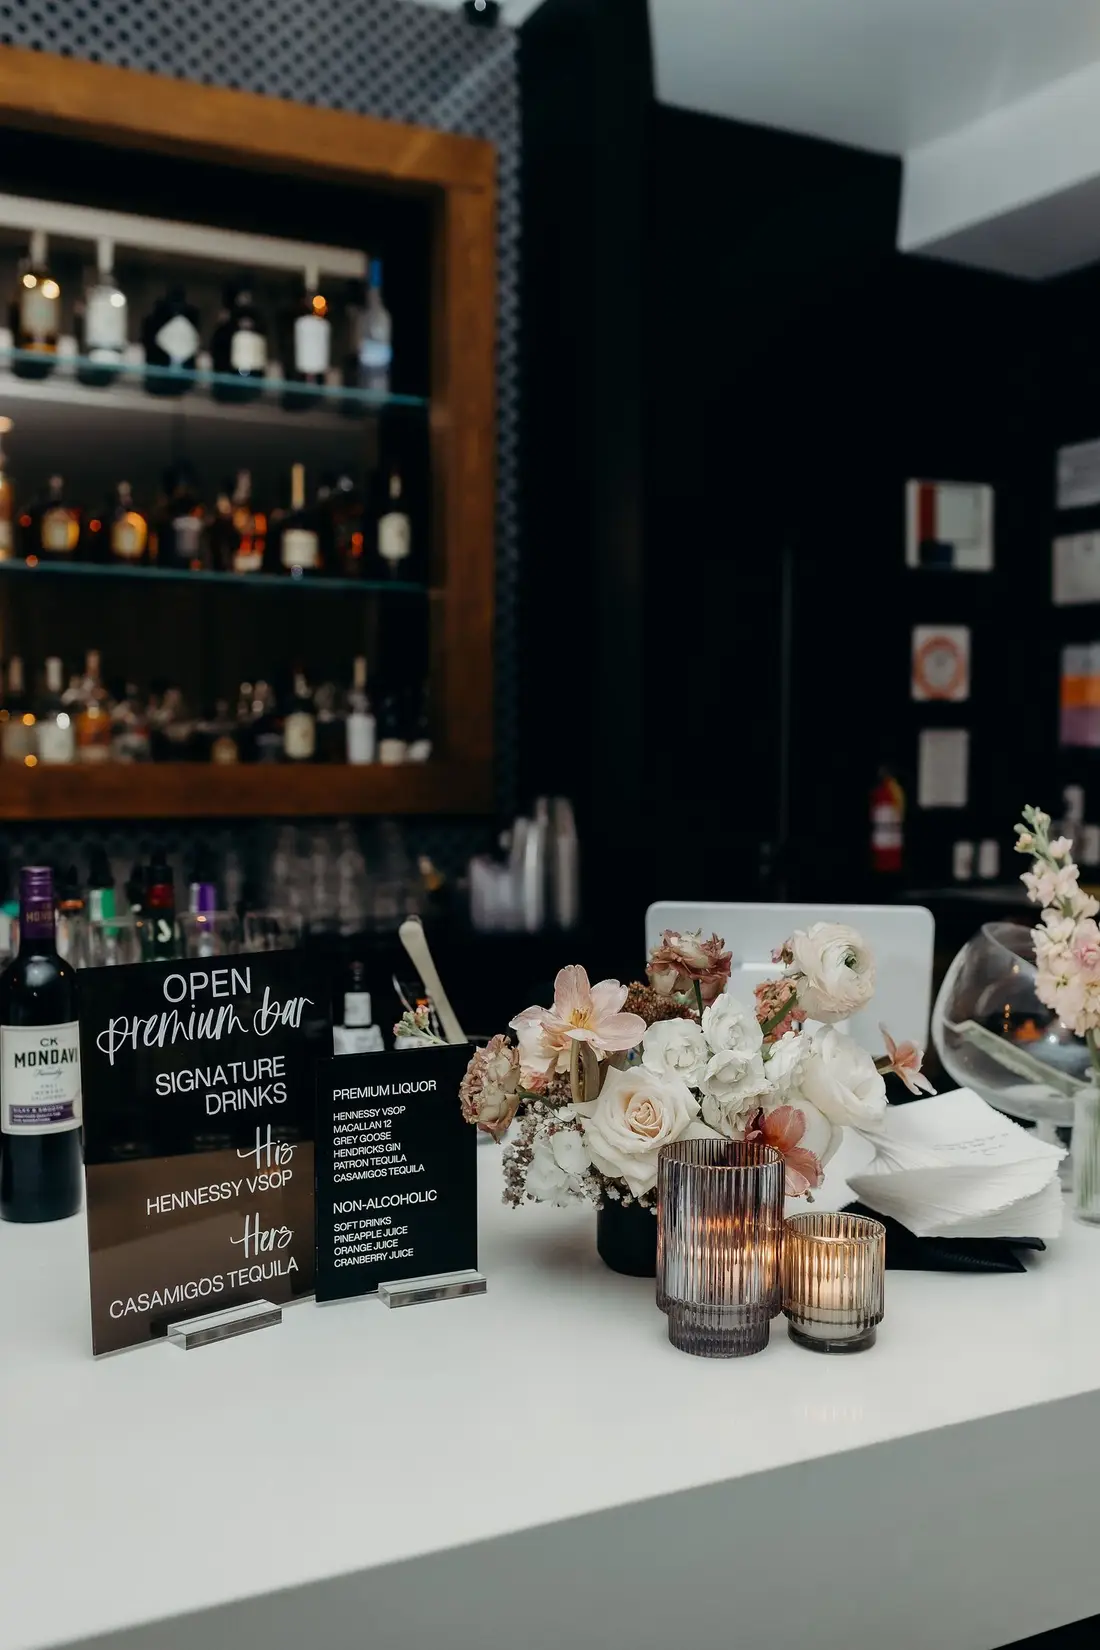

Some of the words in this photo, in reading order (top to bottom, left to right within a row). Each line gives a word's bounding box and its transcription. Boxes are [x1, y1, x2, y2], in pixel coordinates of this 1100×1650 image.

[163, 967, 251, 1003] OPEN
[97, 1004, 249, 1066] premium
[253, 986, 314, 1036] bar
[40, 1037, 58, 1047] CK
[14, 1047, 78, 1068] MONDAVI
[155, 1055, 286, 1096] SIGNATURE
[205, 1082, 287, 1115] DRINKS
[333, 1085, 390, 1101] PREMIUM
[392, 1080, 437, 1095] LIQUOR
[333, 1108, 380, 1121] HENNESSY
[382, 1105, 406, 1116] VSOP
[333, 1121, 382, 1134] MACALLAN
[383, 1119, 392, 1128] 12
[237, 1123, 297, 1169] His
[333, 1135, 358, 1146] GREY
[359, 1131, 392, 1143] GOOSE
[333, 1145, 384, 1158] HENDRICKS
[385, 1142, 401, 1151] GIN
[333, 1159, 369, 1170] PATRON
[370, 1154, 407, 1166] TEQUILA
[333, 1168, 387, 1183] CASAMIGOS
[388, 1163, 425, 1176] TEQUILA
[146, 1179, 243, 1215] HENNESSY
[246, 1170, 293, 1193] VSOP
[333, 1189, 438, 1214] NON-ALCOHOLIC
[334, 1220, 358, 1232] SOFT
[359, 1216, 392, 1229] DRINKS
[230, 1212, 295, 1258] Hers
[334, 1229, 382, 1244] PINEAPPLE
[382, 1226, 408, 1237] JUICE
[334, 1242, 372, 1255] ORANGE
[373, 1239, 399, 1250] JUICE
[334, 1252, 388, 1268] CRANBERRY
[388, 1248, 414, 1260] JUICE
[109, 1275, 224, 1319] CASAMIGOS
[227, 1256, 299, 1288] TEQUILA
